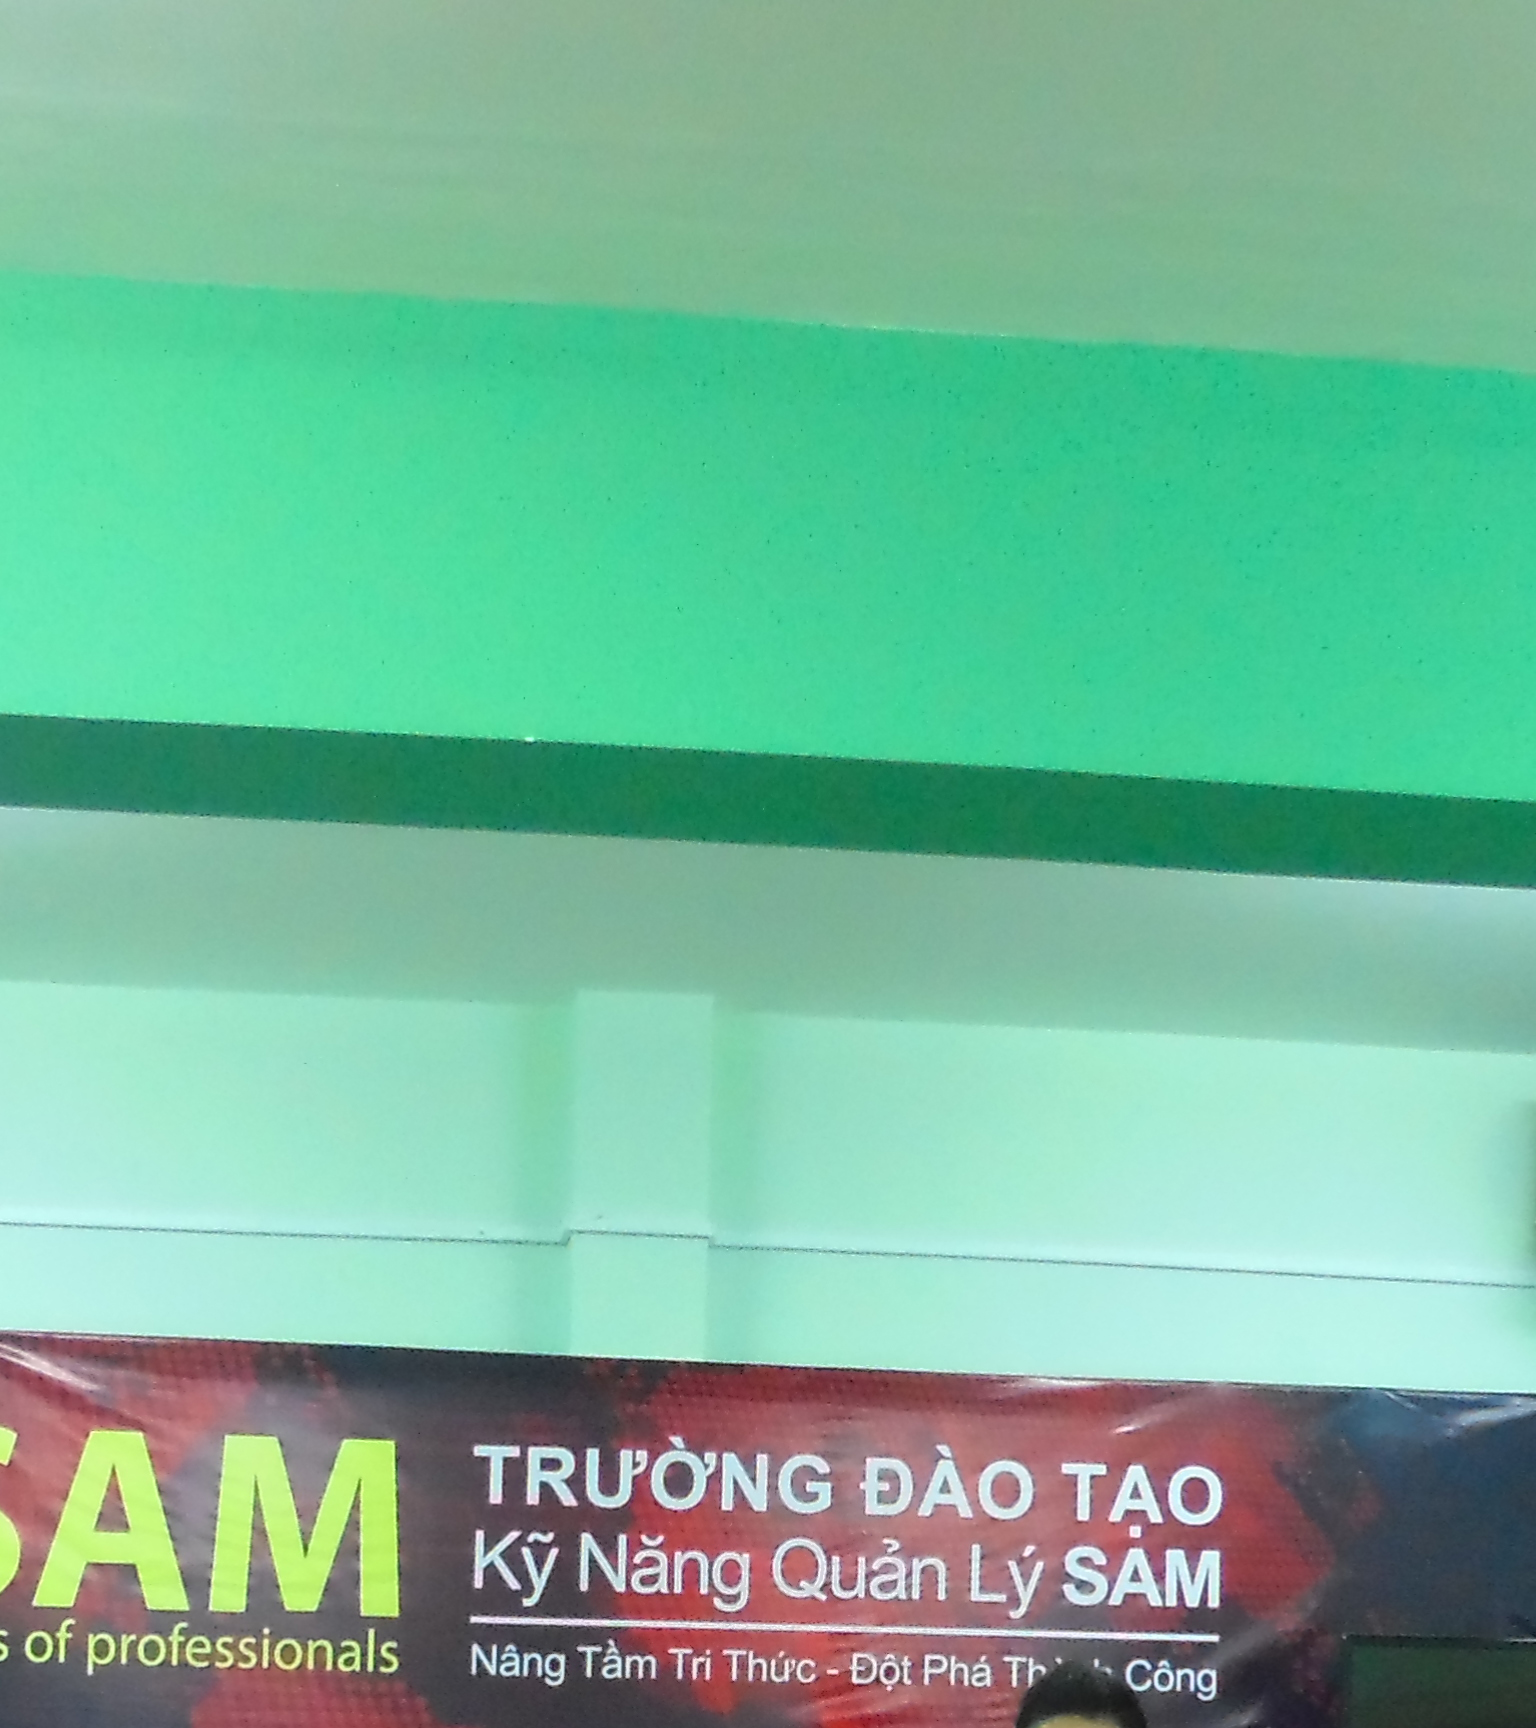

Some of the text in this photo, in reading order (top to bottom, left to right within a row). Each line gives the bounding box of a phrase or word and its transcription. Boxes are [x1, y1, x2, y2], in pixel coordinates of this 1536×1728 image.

[472, 1435, 1224, 1538] TRƯỜNG ĐÀO TẠO
[473, 1529, 1221, 1620] Kỹ Năng Quản Lý SAM
[24, 1618, 77, 1664] of
[87, 1621, 400, 1676] professionals
[469, 1643, 567, 1687] Nâng
[576, 1638, 657, 1680] Tầm
[722, 1650, 818, 1685] Thức
[849, 1652, 913, 1692] Đột
[923, 1653, 993, 1688] Phá
[1124, 1658, 1218, 1702] Công
